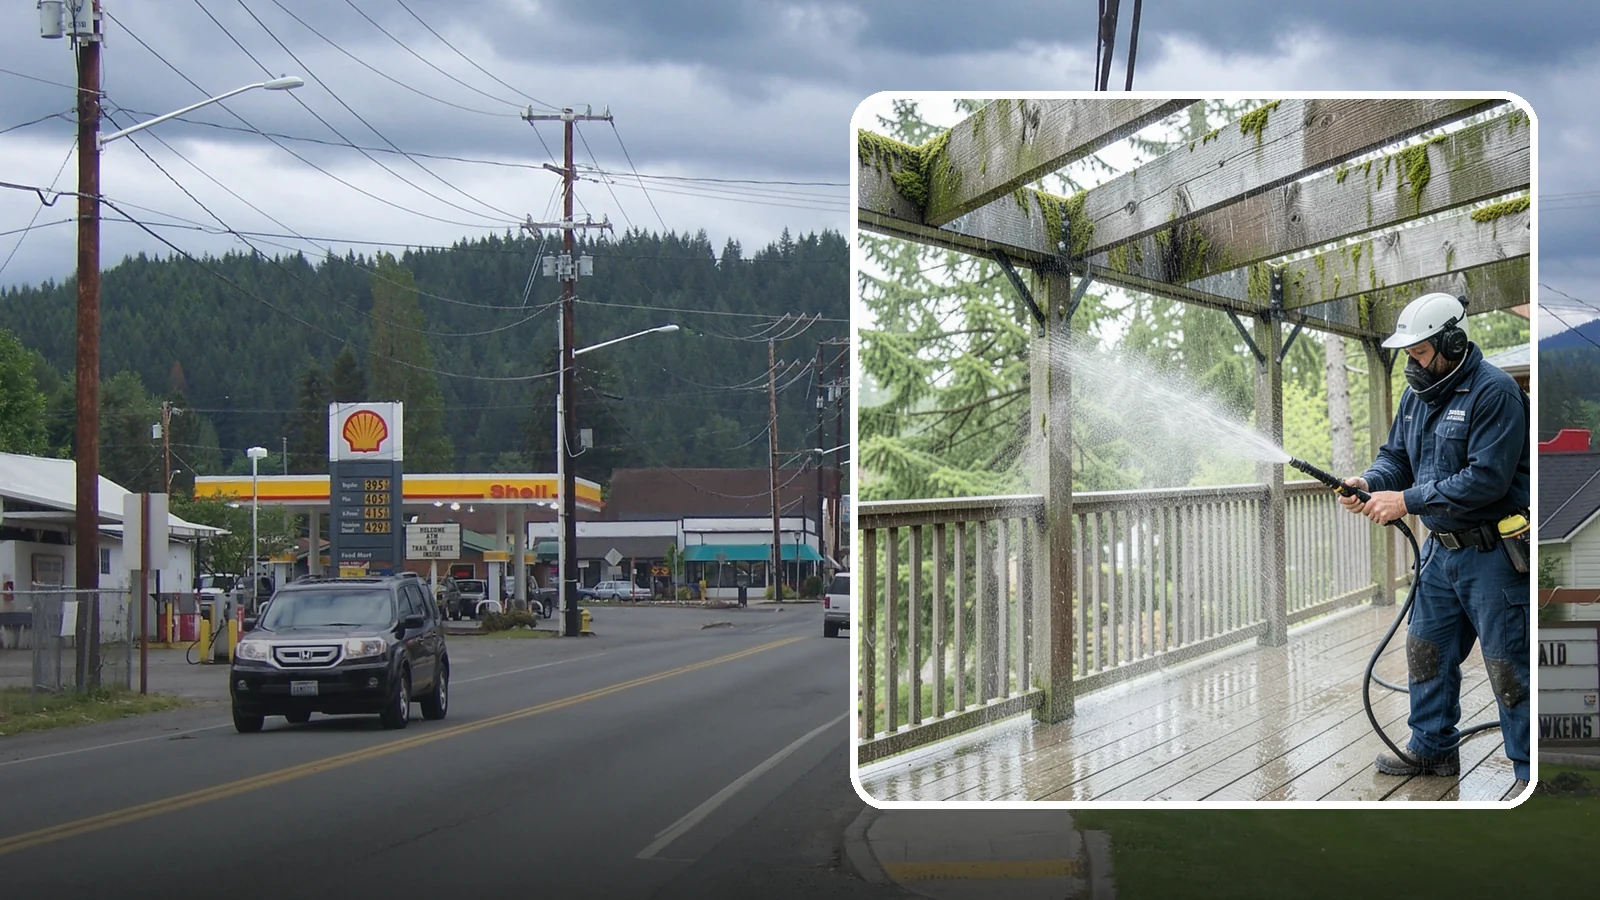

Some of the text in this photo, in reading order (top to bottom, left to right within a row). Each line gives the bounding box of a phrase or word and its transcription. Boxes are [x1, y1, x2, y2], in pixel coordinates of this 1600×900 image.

[366, 480, 383, 490] 395
[490, 484, 547, 499] Shell
[366, 494, 383, 504] 405
[366, 508, 383, 518] 415
[366, 522, 383, 532] 429
[1538, 643, 1567, 665] AID
